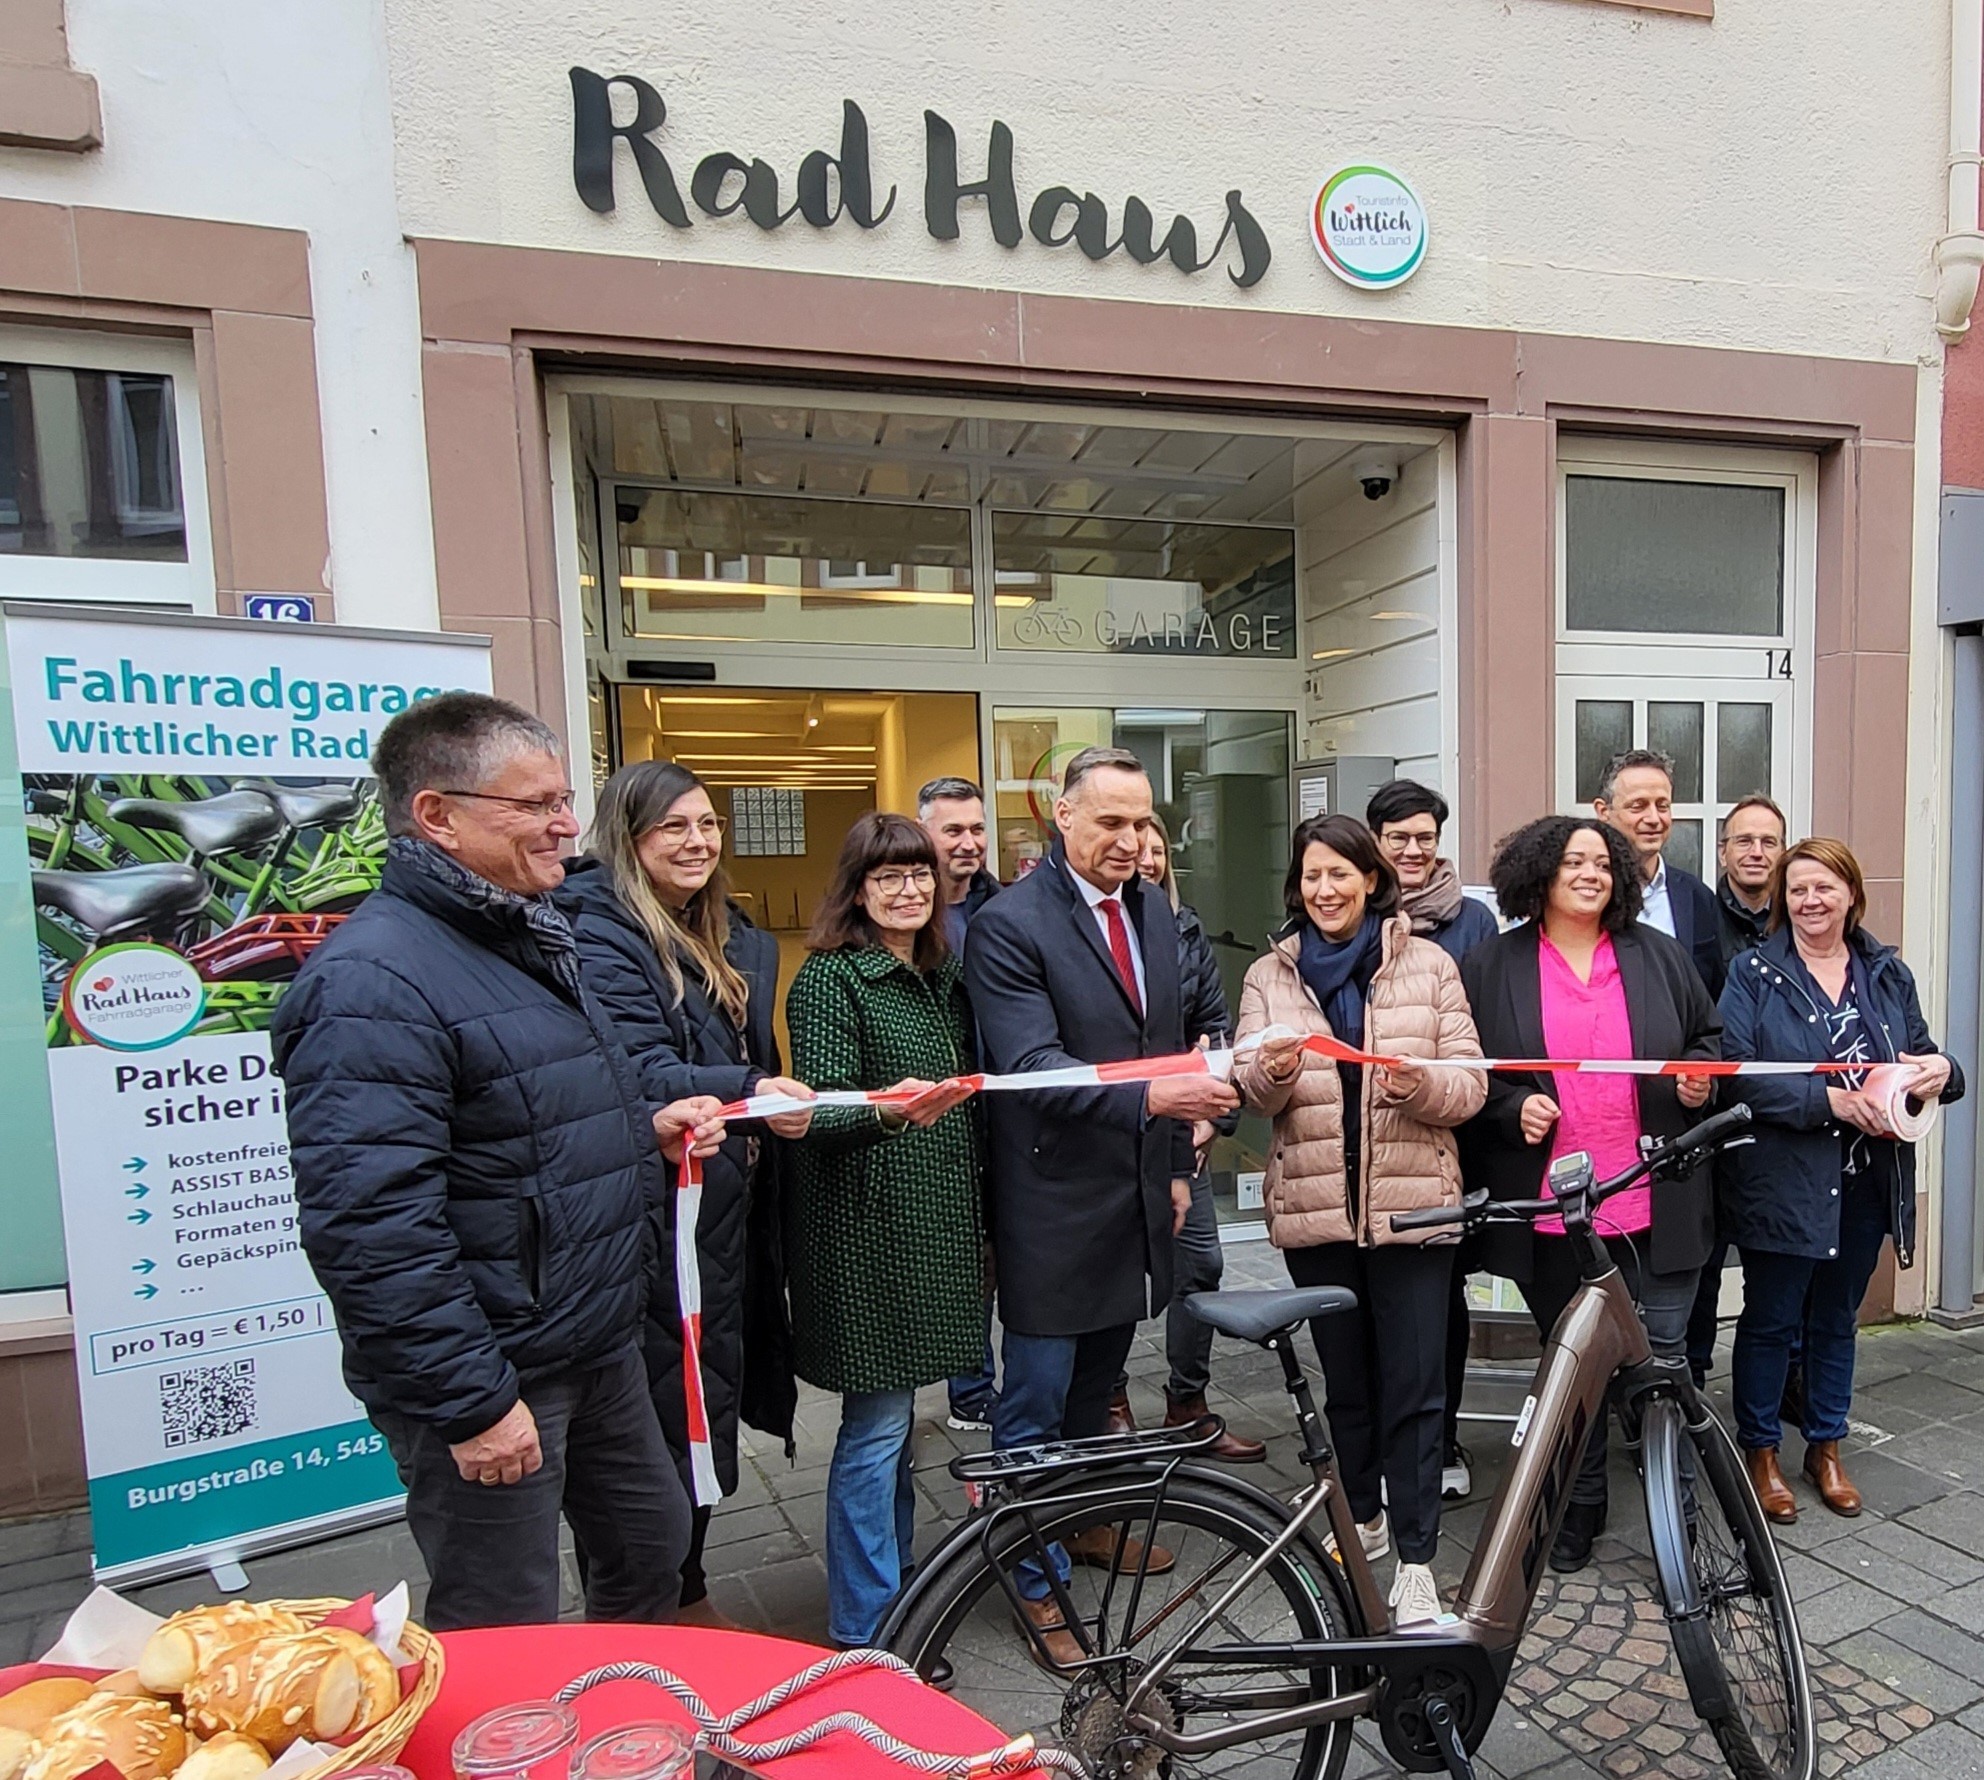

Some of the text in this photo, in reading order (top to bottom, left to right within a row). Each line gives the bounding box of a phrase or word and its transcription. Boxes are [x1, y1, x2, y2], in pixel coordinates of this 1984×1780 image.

[568, 65, 1273, 288] Rad Haus
[1356, 195, 1408, 206] Touristinfo
[1331, 210, 1411, 233] Wittlich
[1333, 234, 1412, 246] Stadt & Land
[258, 602, 301, 624] 16
[1095, 610, 1282, 652] GARAGE
[1765, 650, 1793, 680] 14
[45, 656, 467, 721] Fahrradgara
[48, 719, 369, 760] Wittlicher Rad
[121, 968, 184, 985] Wittlicher
[82, 985, 192, 1012] Rad Haus
[88, 1001, 192, 1024] Fahrradgarage
[116, 1059, 229, 1094] Parke
[144, 1093, 261, 1128] sicher
[168, 1141, 289, 1169] kostenfreie
[171, 1170, 244, 1195] ASSIST
[172, 1192, 296, 1220] Schlauchau
[175, 1218, 277, 1244] Formaten
[177, 1238, 304, 1269] Gepäckspin
[111, 1336, 155, 1363] pro
[161, 1327, 205, 1350] Tag
[211, 1326, 229, 1339] =
[234, 1318, 249, 1336] €
[255, 1308, 306, 1333] 1,50
[127, 1433, 384, 1510] Burgstraße 14, 545
